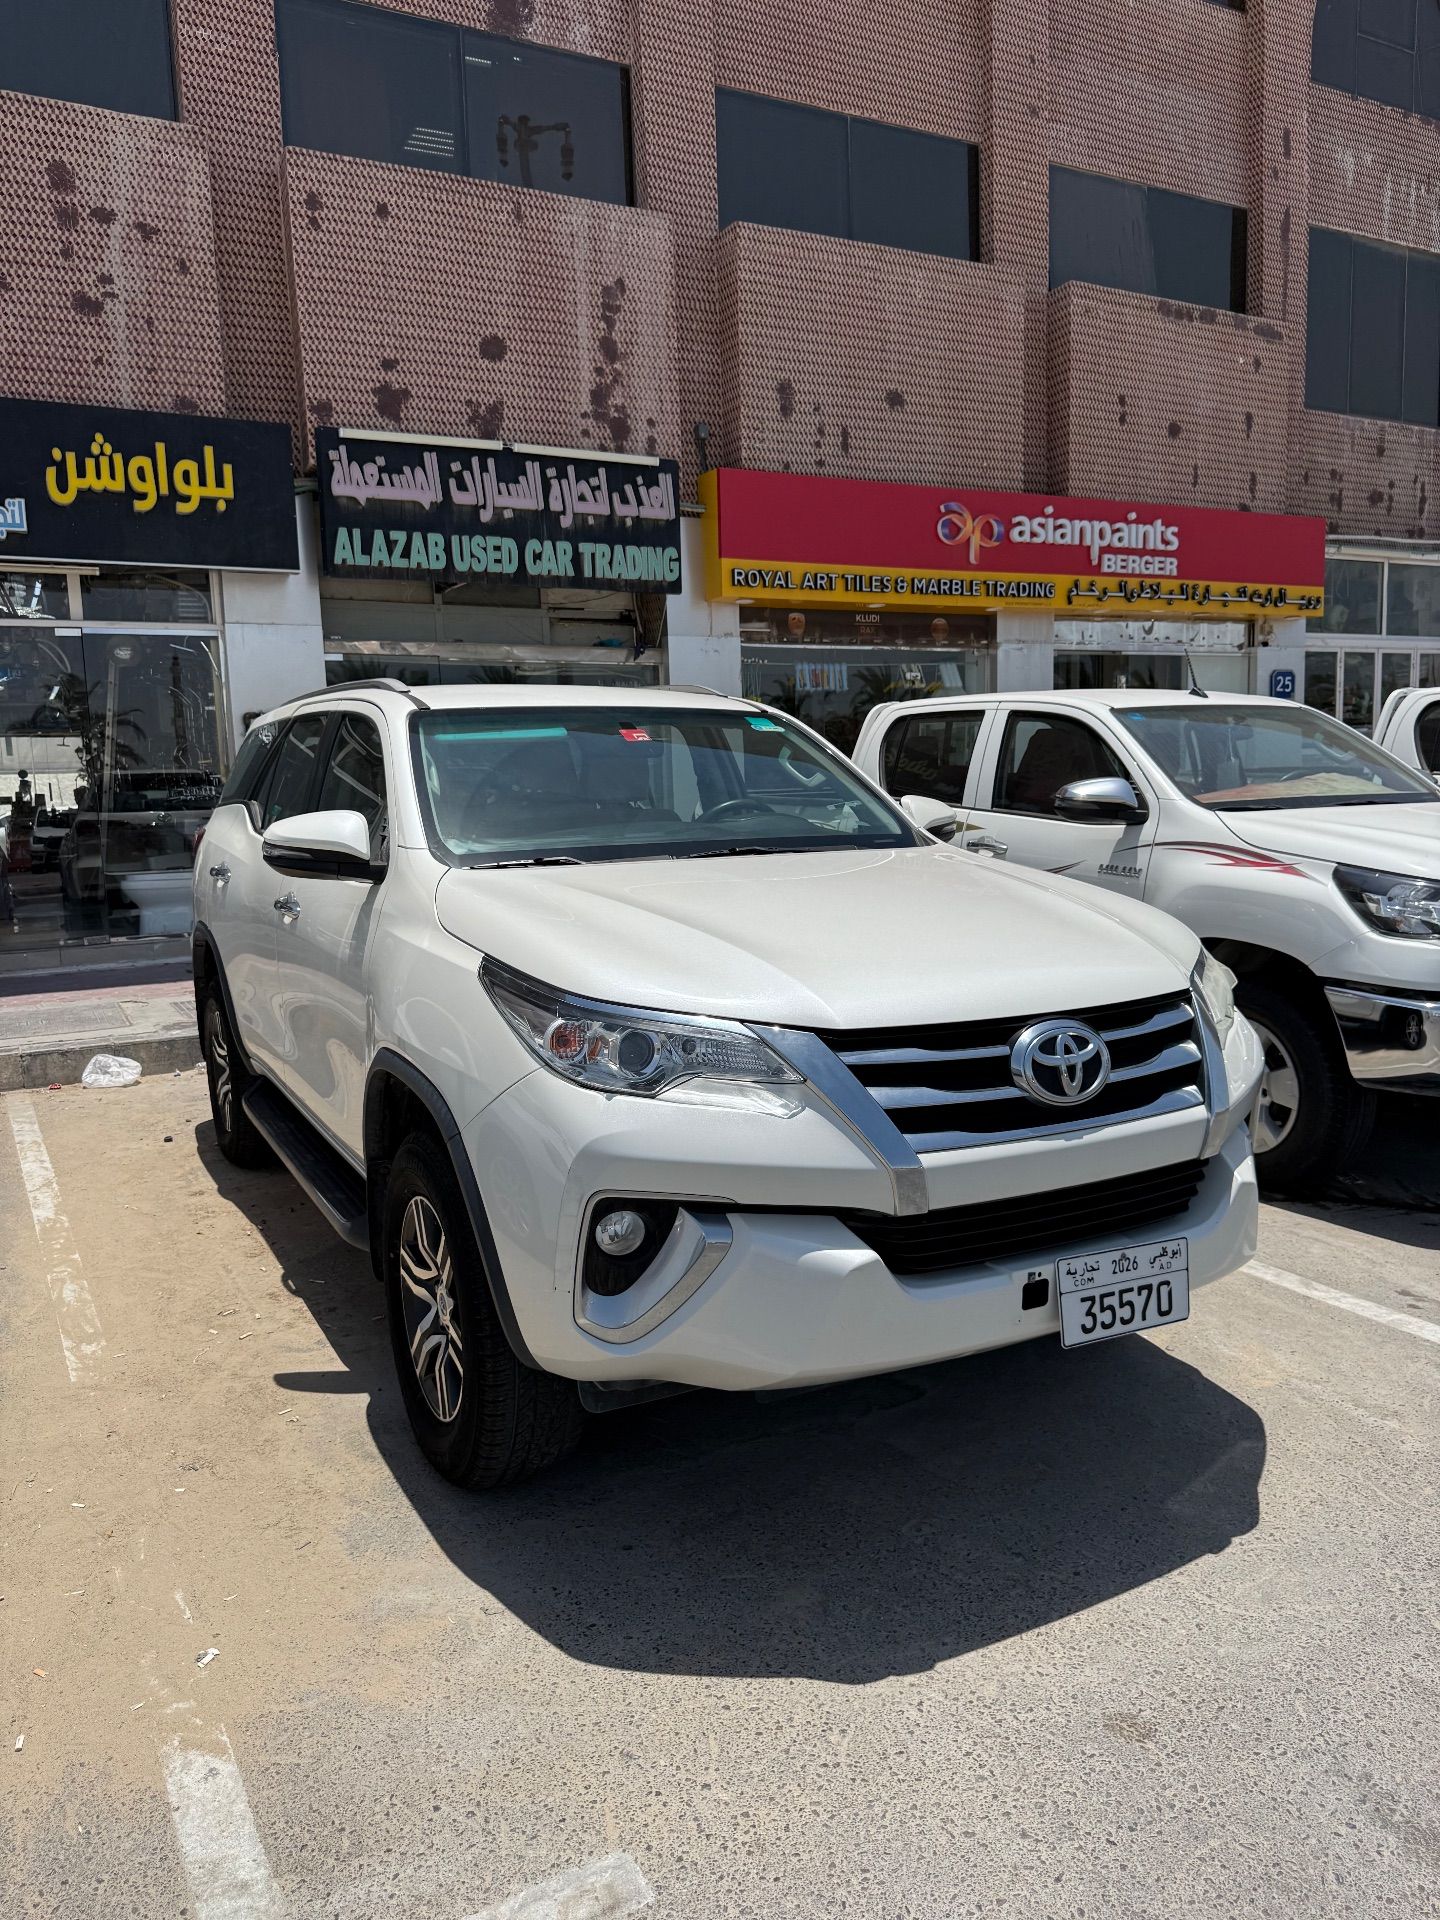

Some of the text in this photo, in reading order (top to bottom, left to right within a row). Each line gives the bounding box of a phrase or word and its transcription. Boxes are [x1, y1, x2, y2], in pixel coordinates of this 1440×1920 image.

[328, 445, 676, 528] العذب لتجارة السيارات المستعملة
[334, 526, 681, 582] ALAZAB USED CAR TRADING
[1101, 553, 1178, 576] BERGER
[732, 568, 1056, 598] ROYAL ART TILES & MARBLE TRADING
[855, 613, 880, 624] KLUDI
[1275, 675, 1292, 692] 25
[1111, 1256, 1139, 1275] 2026
[1073, 1276, 1095, 1288] COM
[1080, 1279, 1173, 1335] 35570
